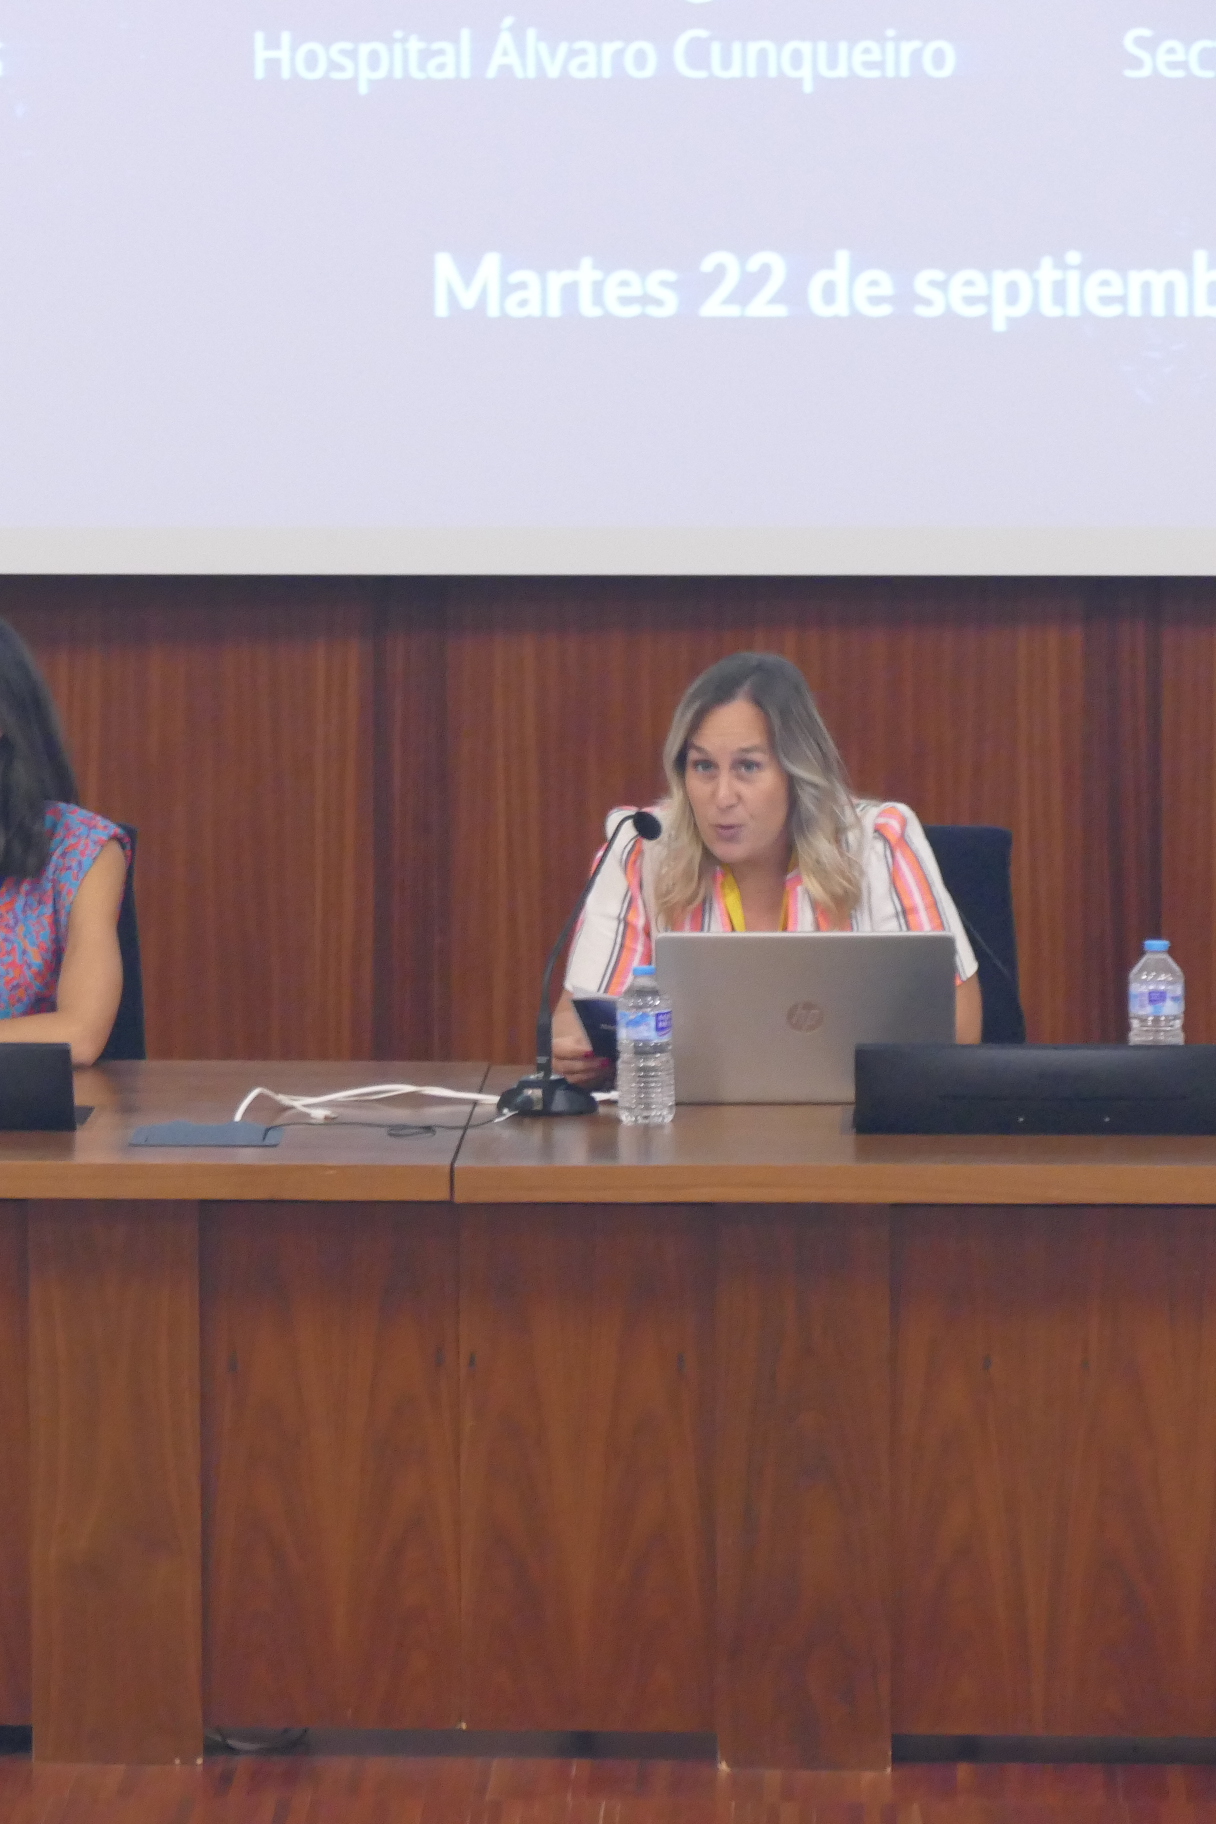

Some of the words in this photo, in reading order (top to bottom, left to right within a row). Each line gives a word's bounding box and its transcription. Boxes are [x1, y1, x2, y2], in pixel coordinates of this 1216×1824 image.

[252, 27, 473, 96] Hospital
[485, 15, 659, 80] Álvaro
[672, 28, 958, 95] Cunqueiro
[1122, 27, 1216, 79] Sec
[433, 250, 680, 319] Martes
[698, 250, 789, 318] 22
[807, 249, 895, 319] de
[913, 249, 1216, 333] septiemb
[789, 1001, 822, 1032] hp
